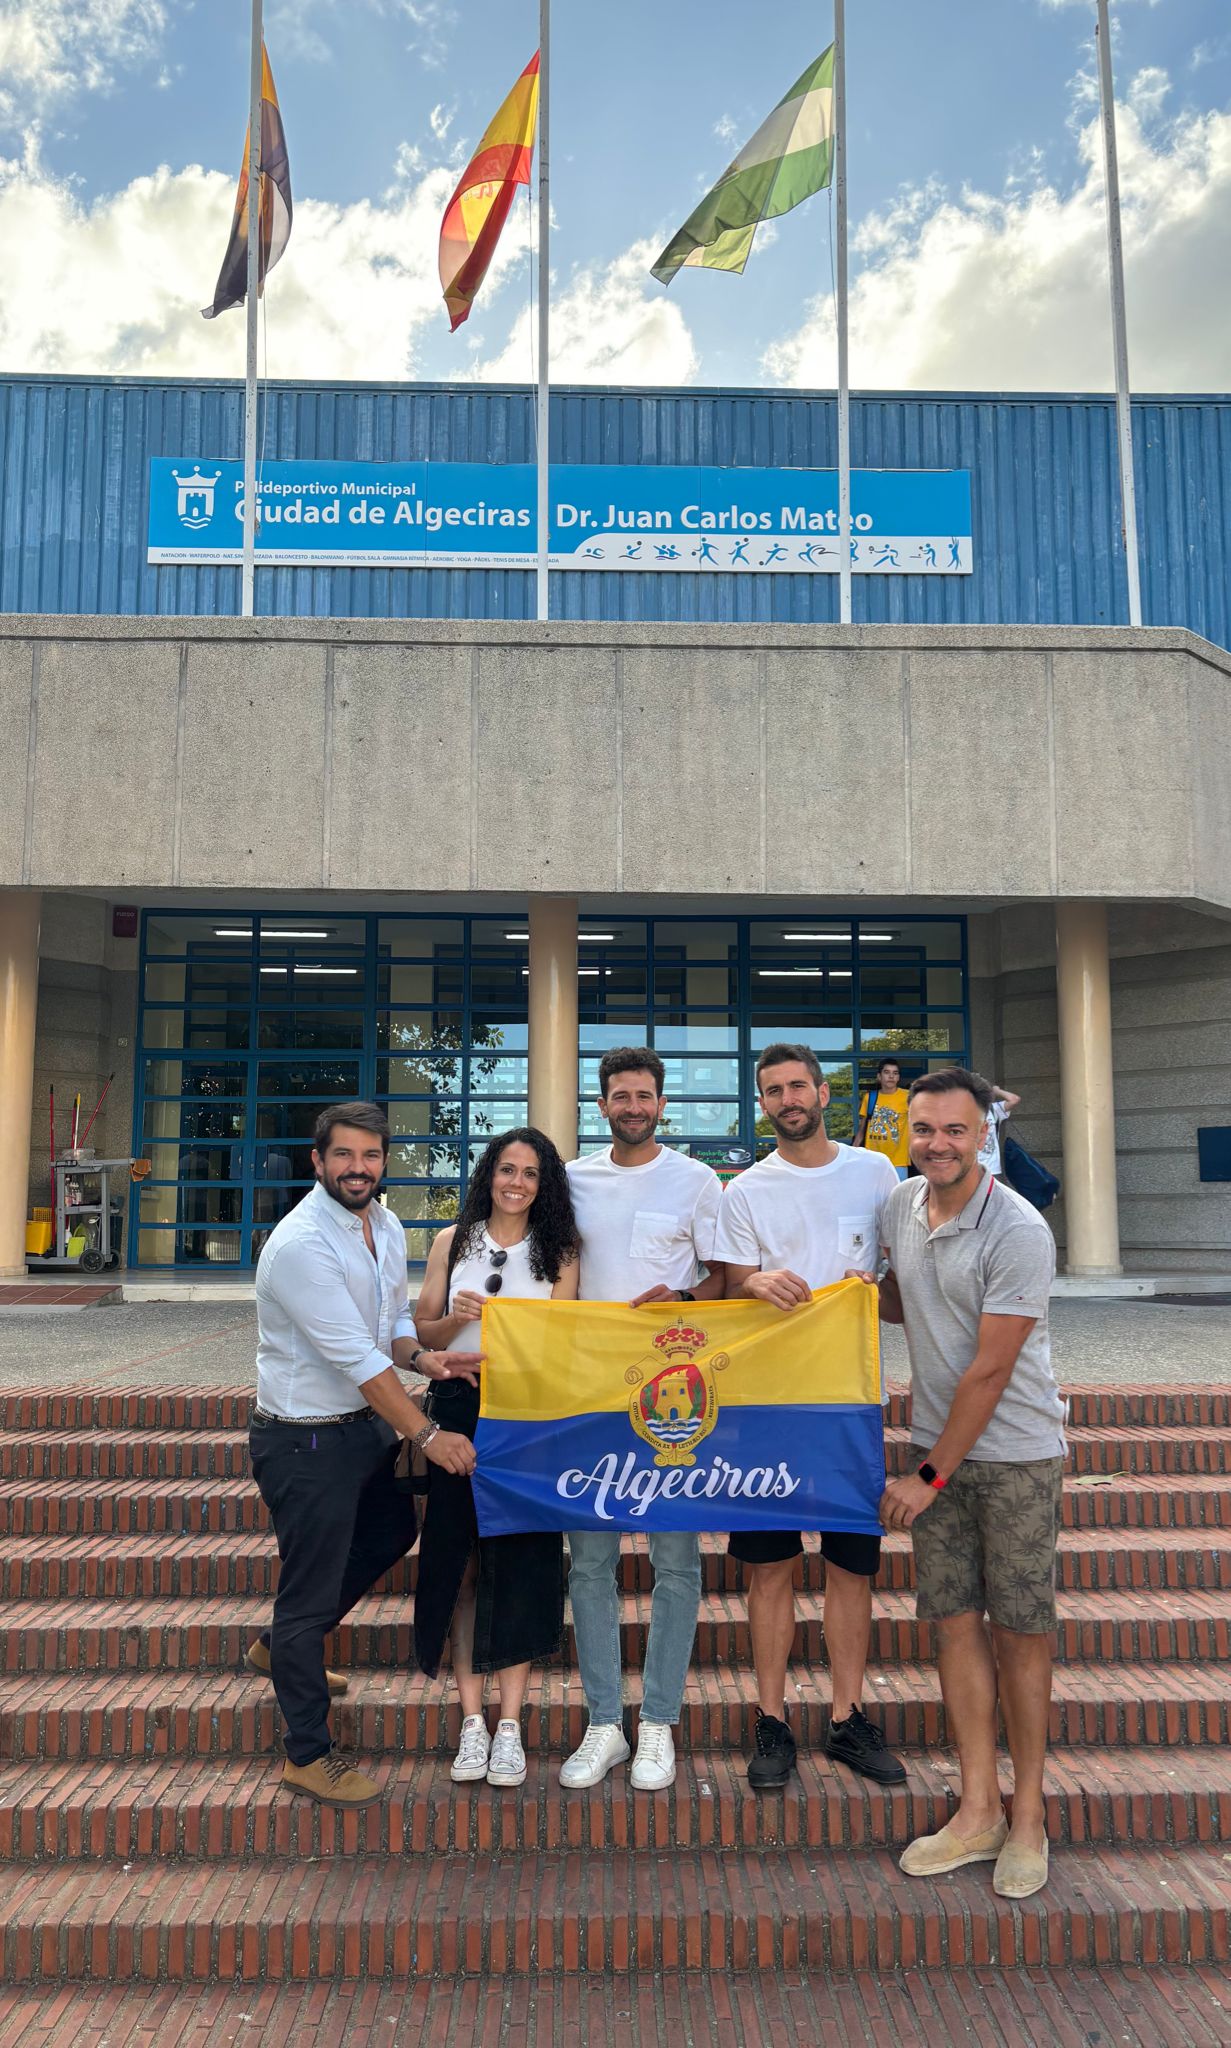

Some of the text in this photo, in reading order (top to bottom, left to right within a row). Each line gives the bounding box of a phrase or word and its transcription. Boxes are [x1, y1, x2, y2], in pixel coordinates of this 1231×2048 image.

[235, 480, 416, 498] Plideportivo Municipal
[348, 499, 386, 525] de
[393, 500, 531, 532] Algeciras
[556, 503, 598, 528] Dr.
[602, 504, 673, 529] Juan
[680, 504, 773, 531] Carlos
[556, 1451, 801, 1520] Algeciras
